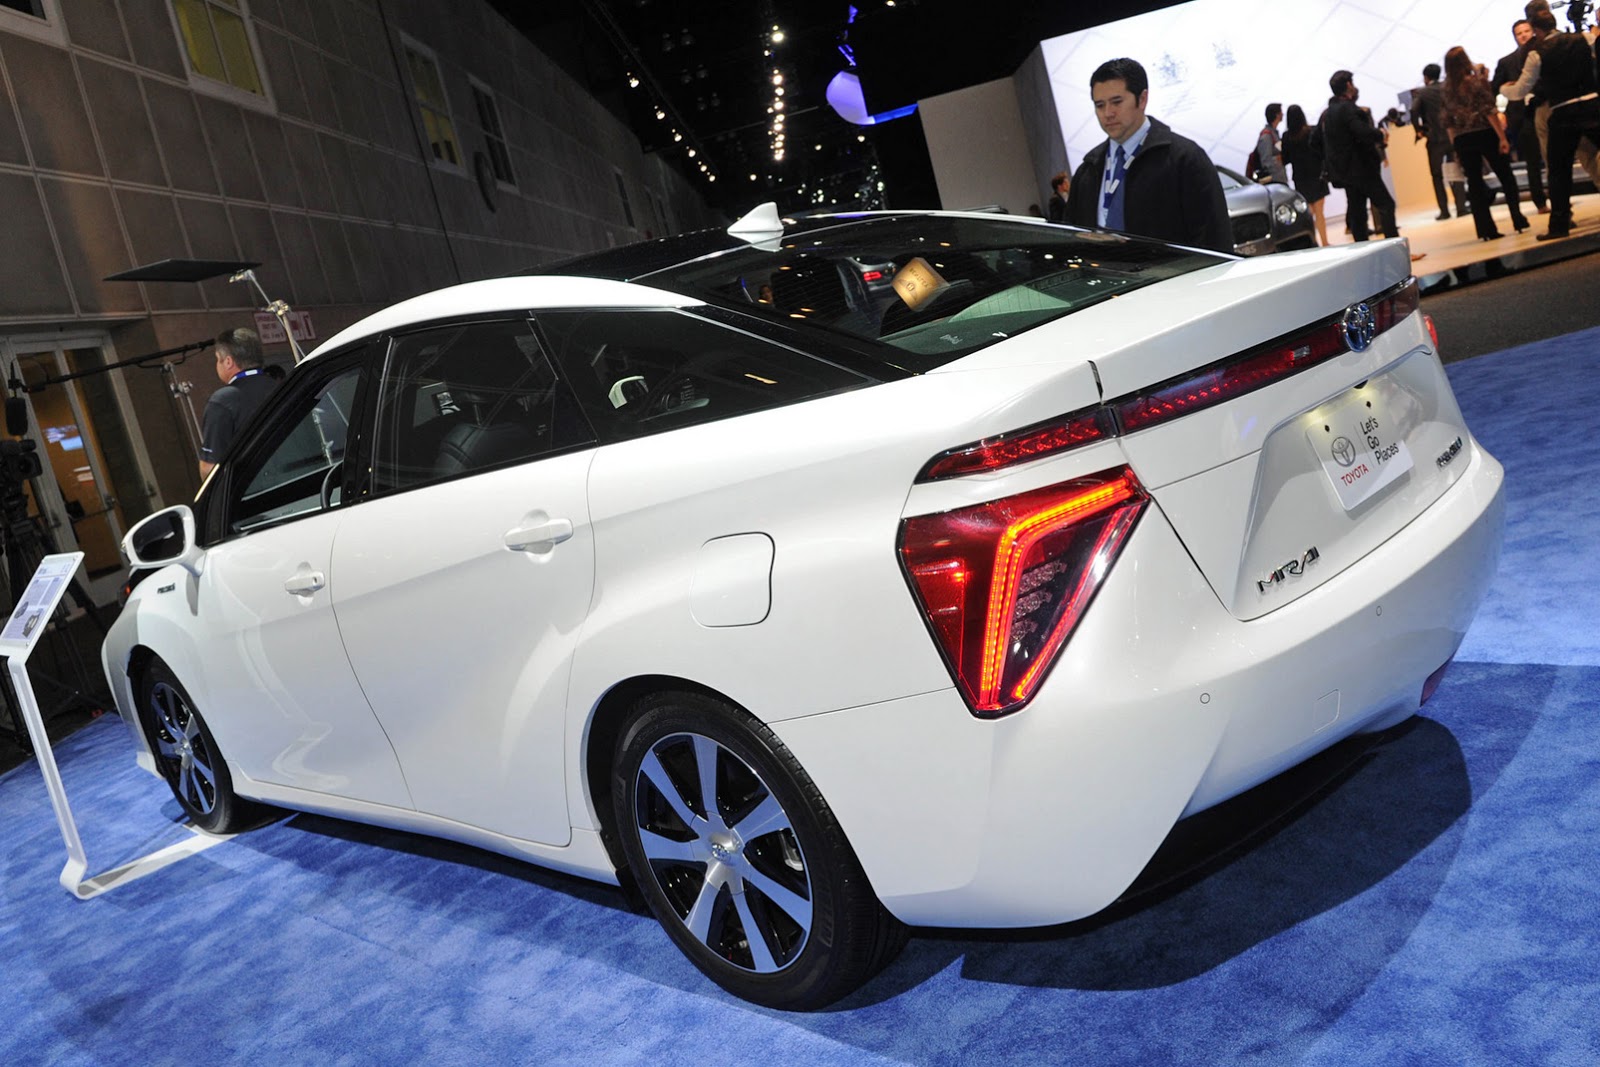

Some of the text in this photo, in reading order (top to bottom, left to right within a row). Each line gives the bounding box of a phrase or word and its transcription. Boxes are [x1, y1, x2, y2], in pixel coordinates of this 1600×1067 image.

[1360, 416, 1379, 435] Let's
[1367, 435, 1380, 450] Go
[1374, 443, 1400, 465] Places
[1340, 463, 1369, 487] TOYOTA
